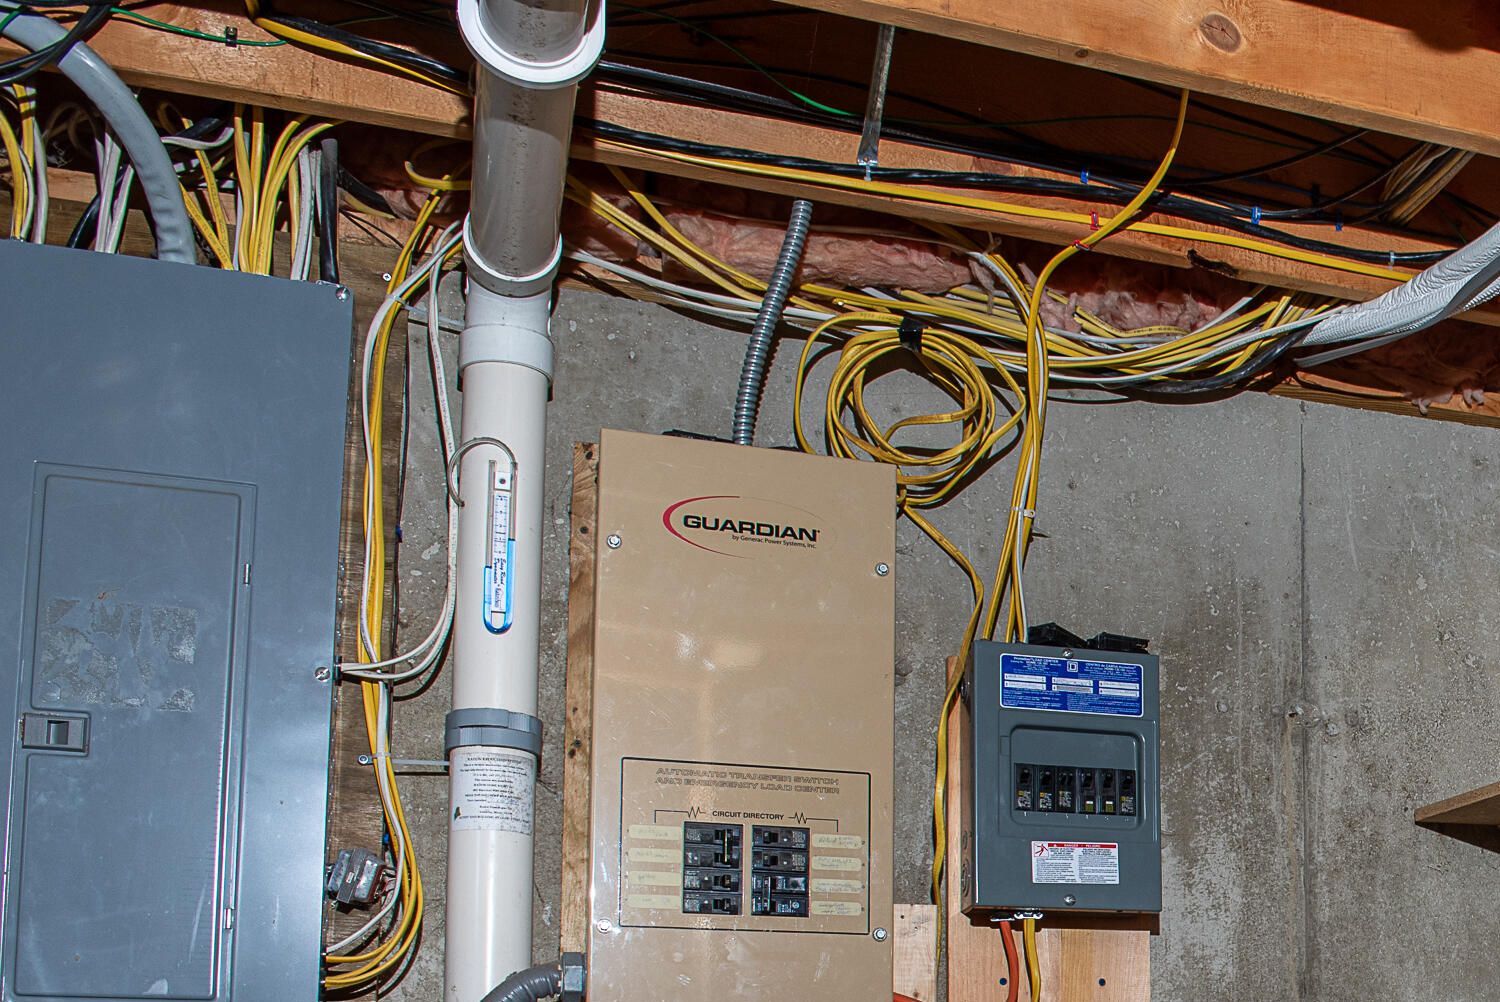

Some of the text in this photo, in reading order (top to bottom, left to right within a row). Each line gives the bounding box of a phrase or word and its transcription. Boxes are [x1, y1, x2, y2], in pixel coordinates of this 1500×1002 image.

[682, 514, 817, 542] GUARDIAN
[732, 534, 739, 542] by
[740, 535, 764, 543] Generac
[655, 767, 839, 786] AUTOMATIC TRANSFER SWITCH
[684, 778, 759, 790] EMERGENCY
[760, 782, 793, 792] LOAD
[794, 784, 840, 794] CENTER
[712, 810, 784, 820] CIRCUIT DIRECTORY
